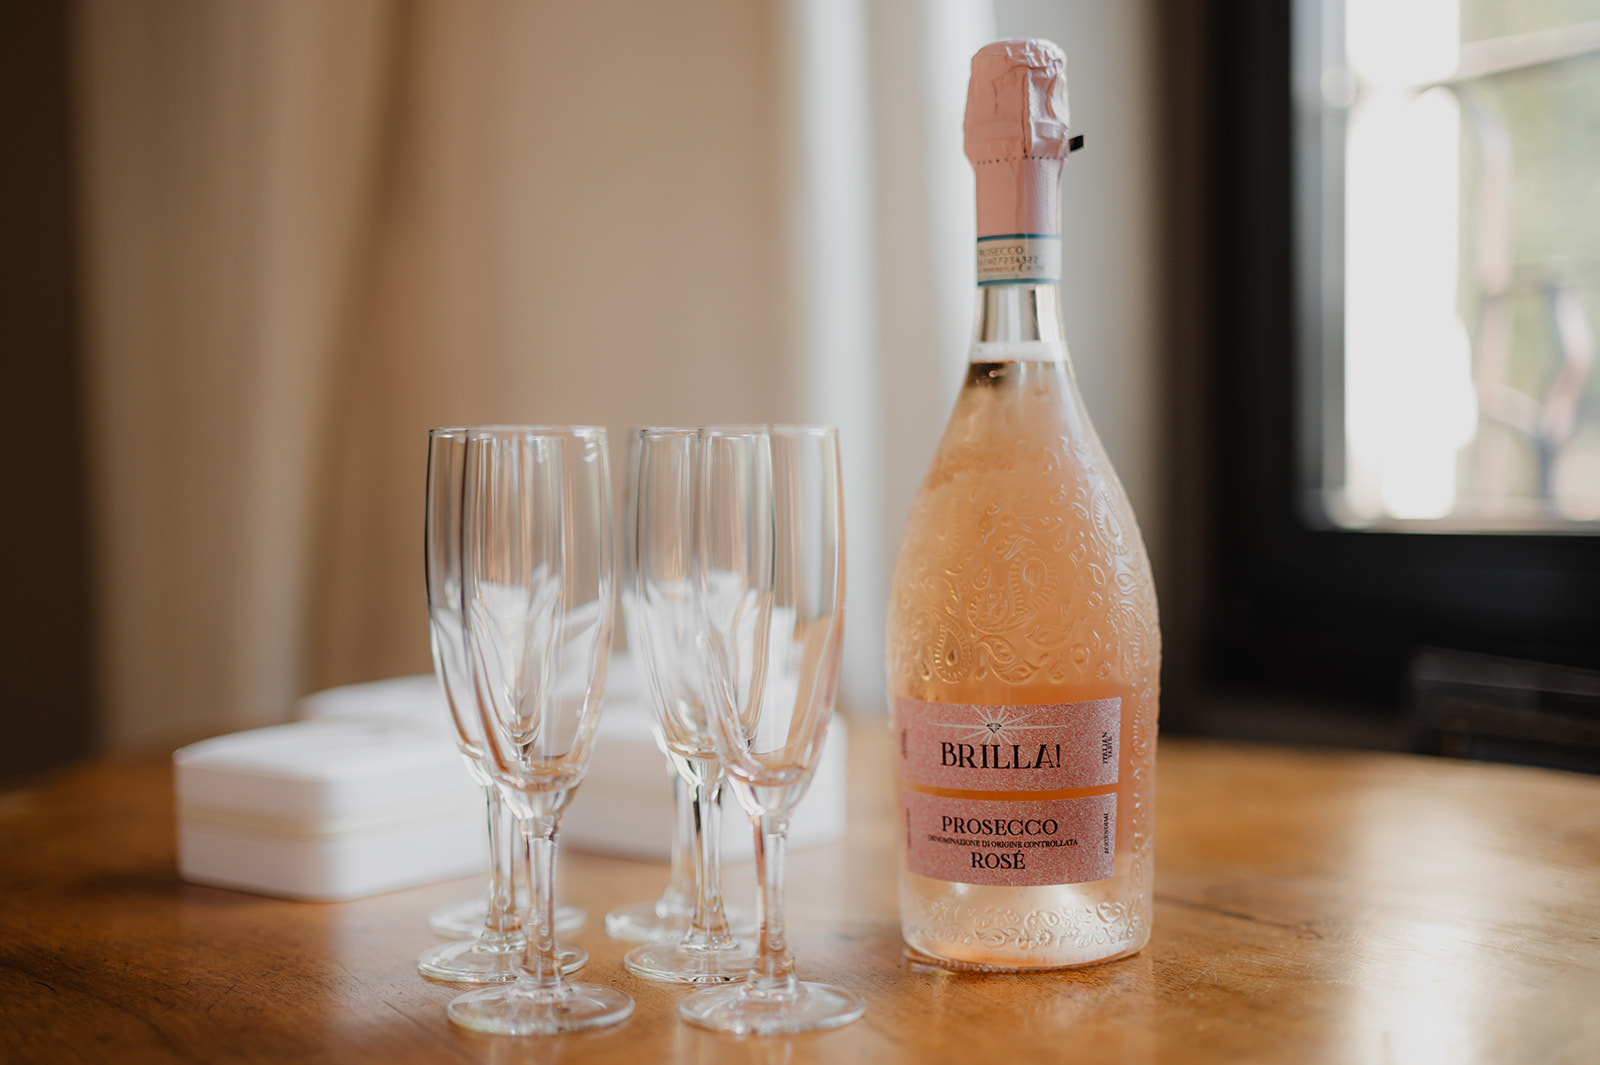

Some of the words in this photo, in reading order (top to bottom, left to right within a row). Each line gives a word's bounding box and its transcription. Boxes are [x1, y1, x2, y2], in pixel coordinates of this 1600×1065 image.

[940, 741, 1061, 769] BRILLA!
[941, 815, 1058, 836] PROSECCO
[928, 834, 981, 847] DENOMINAZIONE
[982, 839, 990, 847] DI
[991, 839, 1023, 849] ORIGINE
[1023, 838, 1078, 849] CONTROLLATA
[970, 850, 1026, 870] ROSÉ
